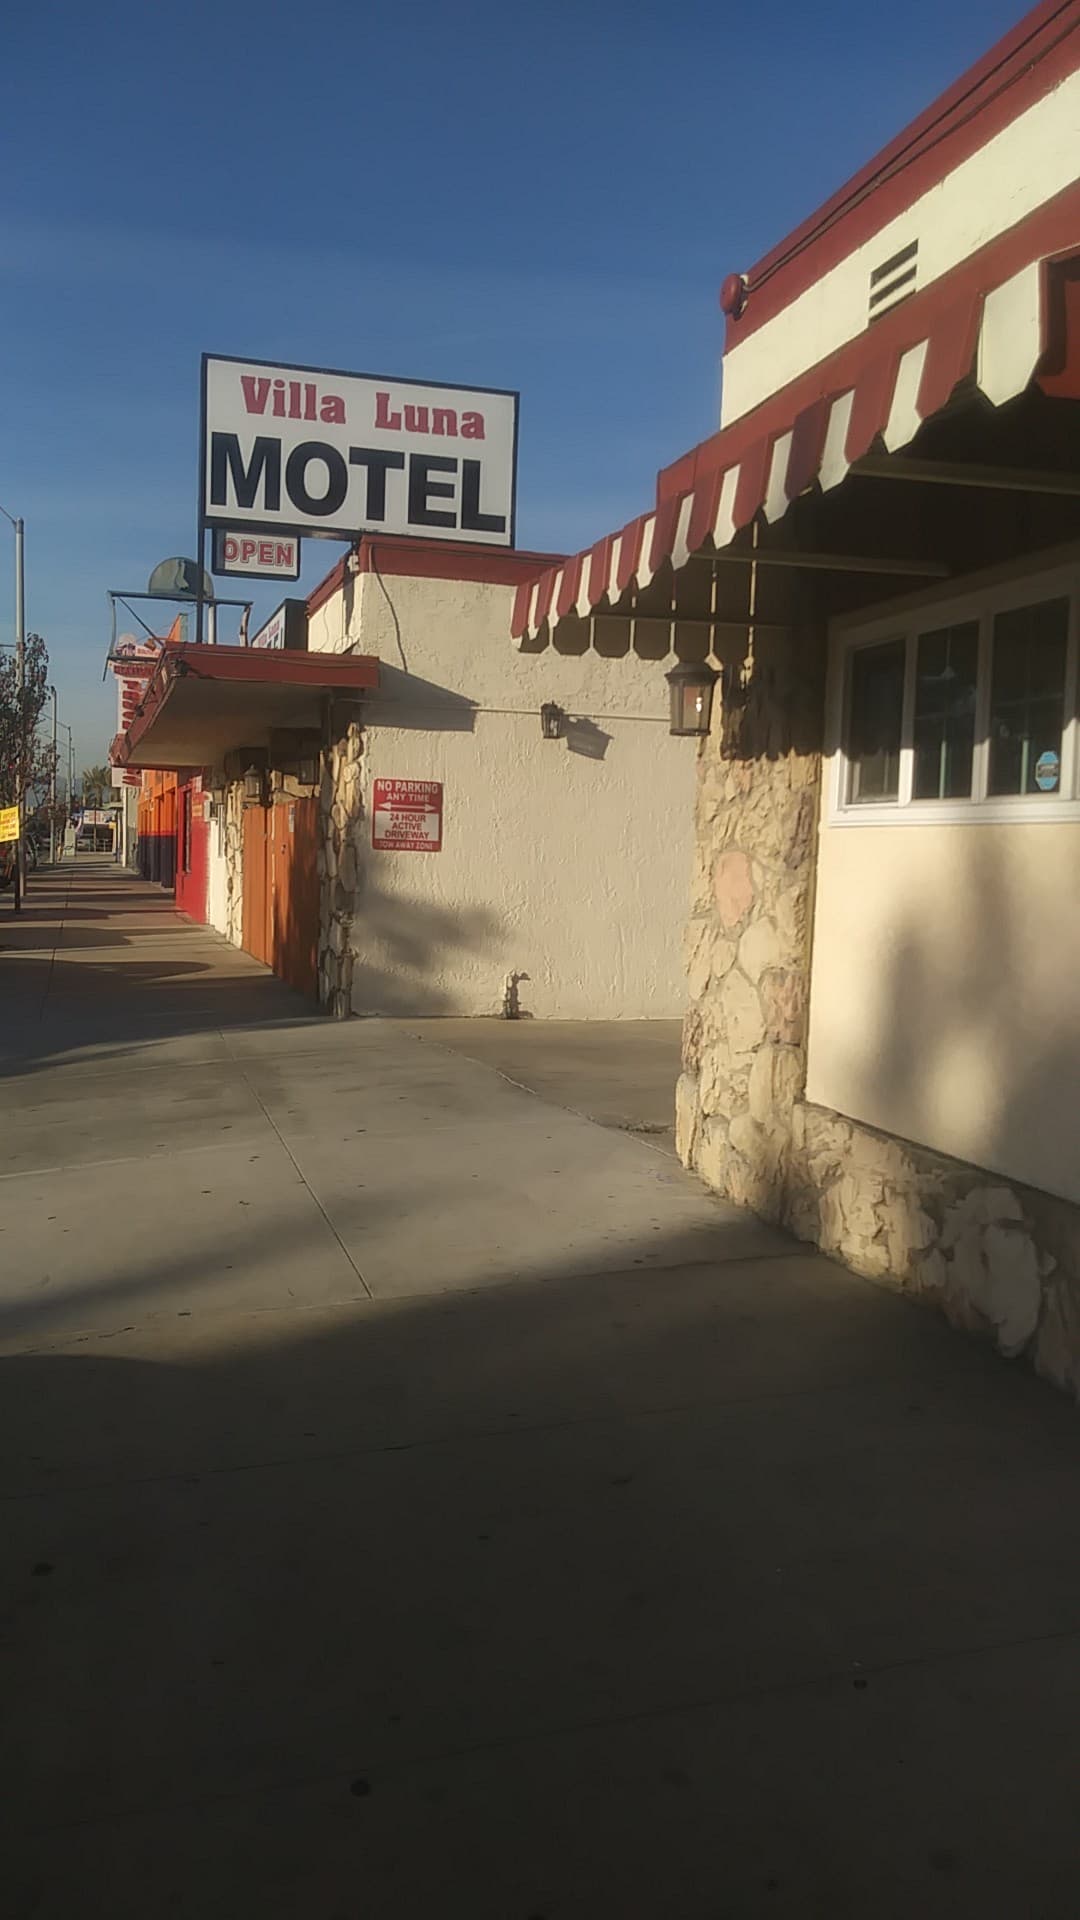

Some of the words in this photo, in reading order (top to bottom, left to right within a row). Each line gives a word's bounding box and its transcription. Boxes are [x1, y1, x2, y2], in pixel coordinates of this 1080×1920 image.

[240, 375, 346, 424] Villa
[375, 392, 486, 440] Luna
[210, 431, 506, 533] MOTEL
[223, 539, 294, 567] OPEN
[377, 781, 392, 791] NO
[396, 782, 438, 794] PARKING
[408, 793, 430, 802] TIME
[390, 813, 399, 821] 24
[401, 814, 426, 822] HOUR
[392, 822, 422, 830] ACTIVE
[384, 830, 429, 839] DRIVEWAY
